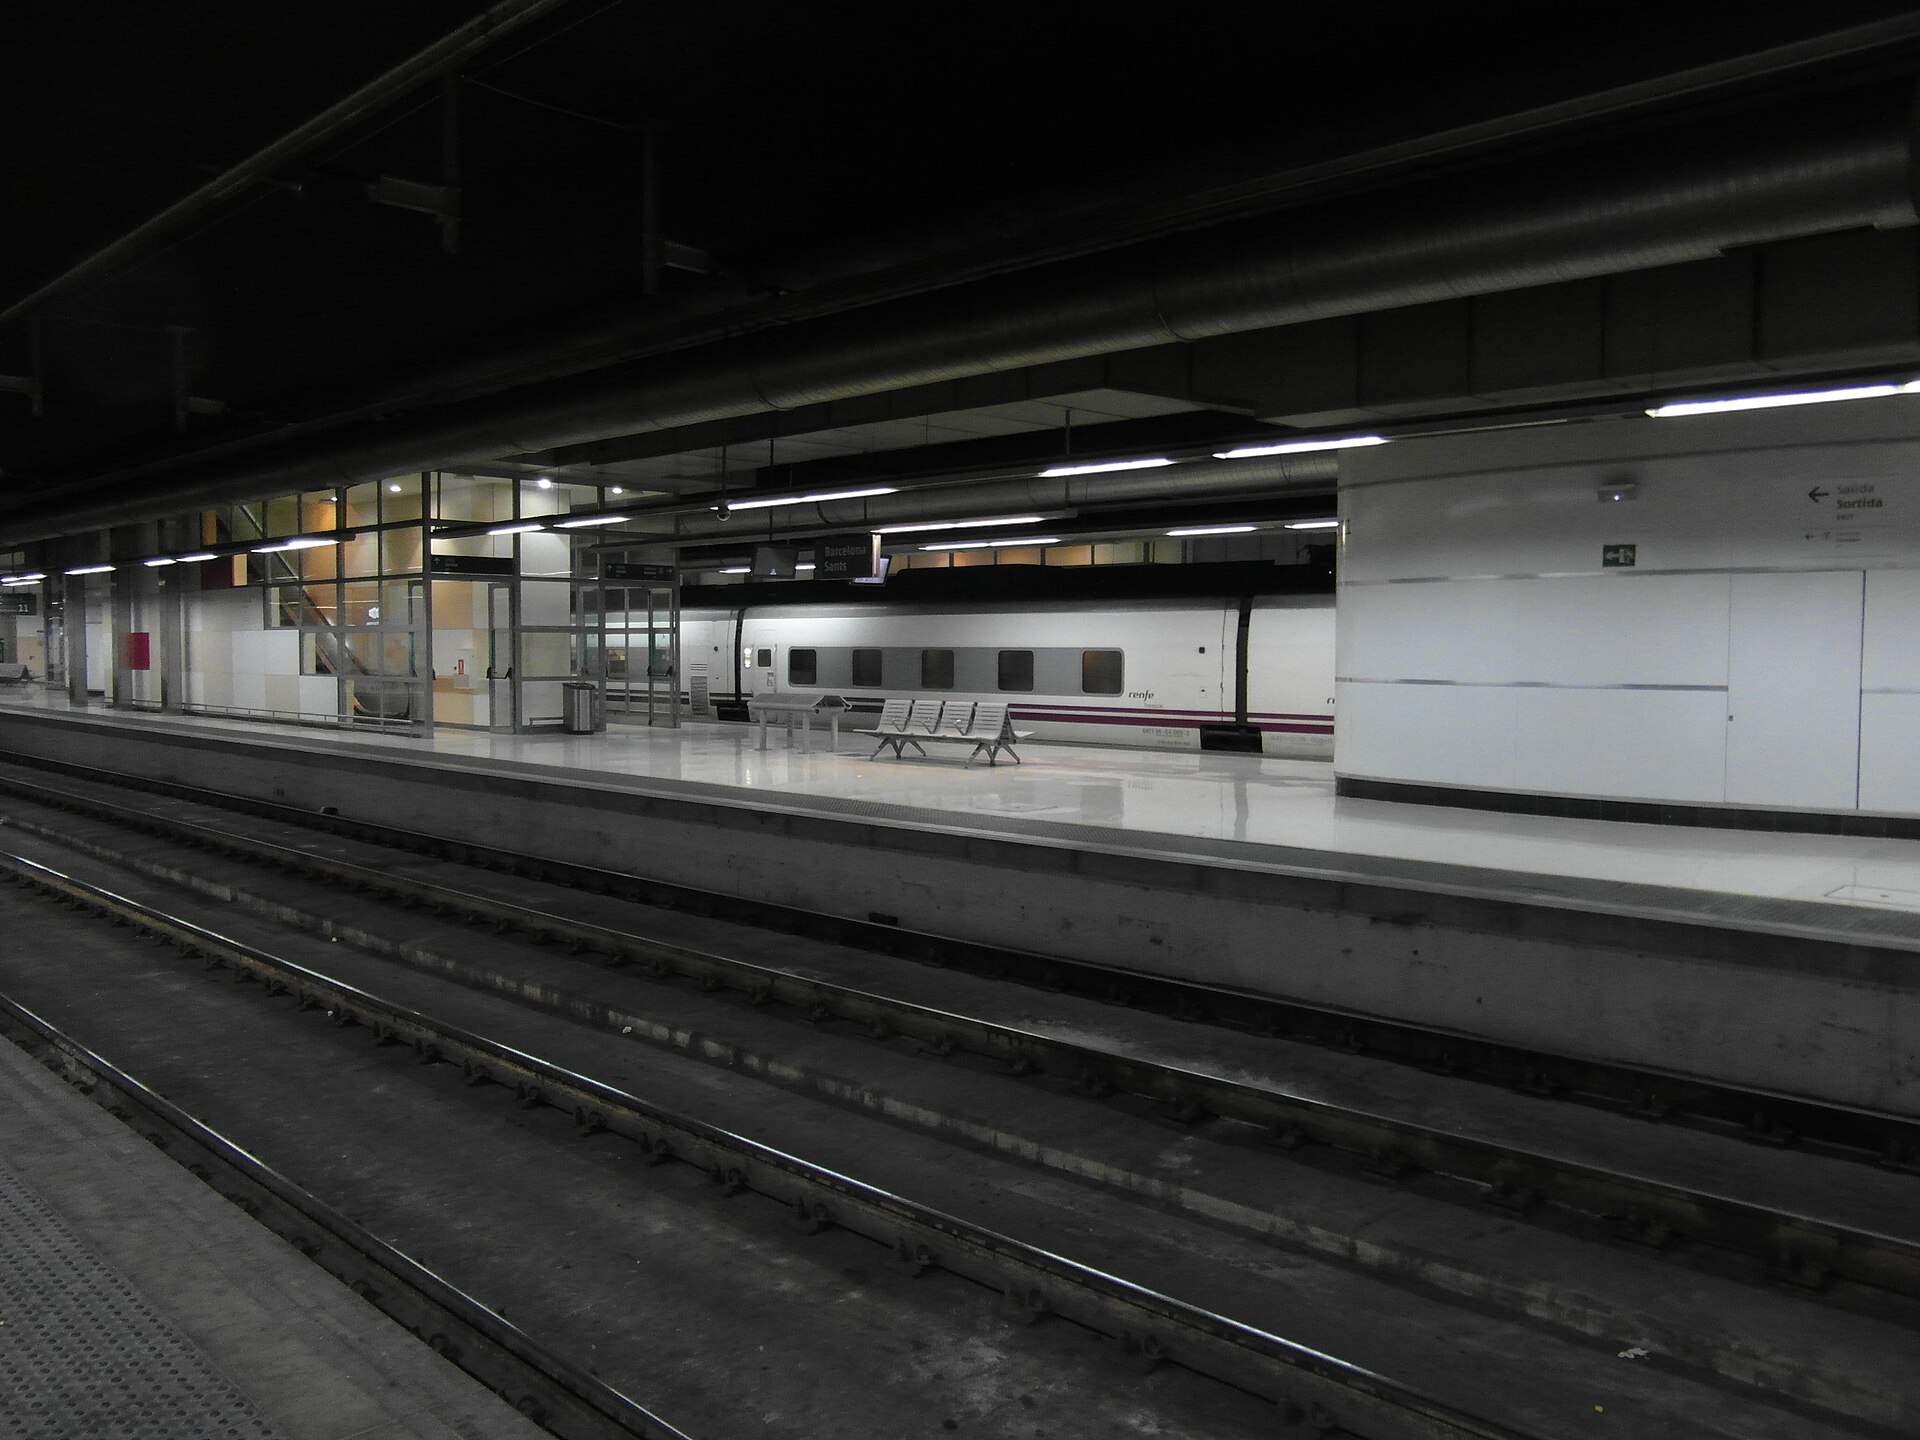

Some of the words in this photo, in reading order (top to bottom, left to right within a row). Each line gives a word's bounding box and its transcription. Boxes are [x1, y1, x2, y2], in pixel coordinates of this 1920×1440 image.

[1836, 498, 1883, 509] Sortida
[824, 545, 866, 557] Barcelona
[824, 560, 848, 572] Sants
[17, 604, 29, 613] 11
[1128, 689, 1155, 702] renfe
